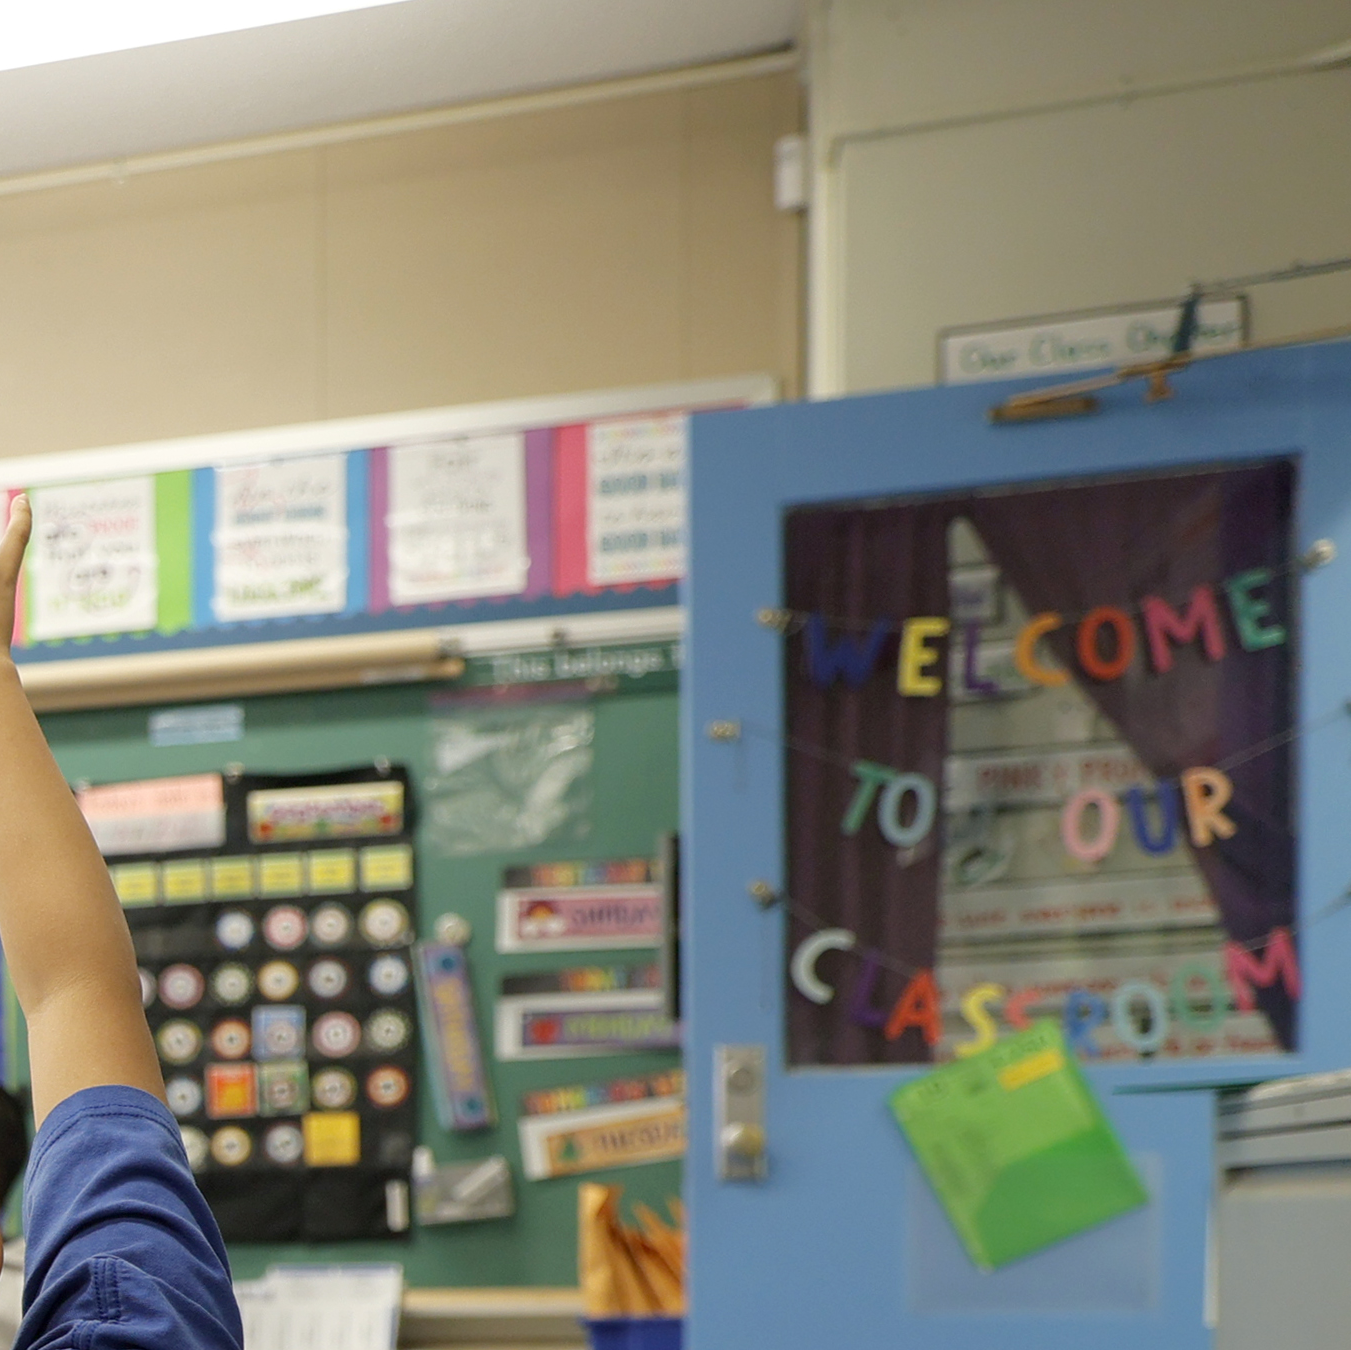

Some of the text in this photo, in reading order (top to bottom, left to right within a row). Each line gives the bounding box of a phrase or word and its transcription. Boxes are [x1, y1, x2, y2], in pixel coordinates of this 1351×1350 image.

[805, 568, 1287, 698] WELCOME
[840, 758, 938, 848] TO
[1060, 765, 1238, 860] OUR
